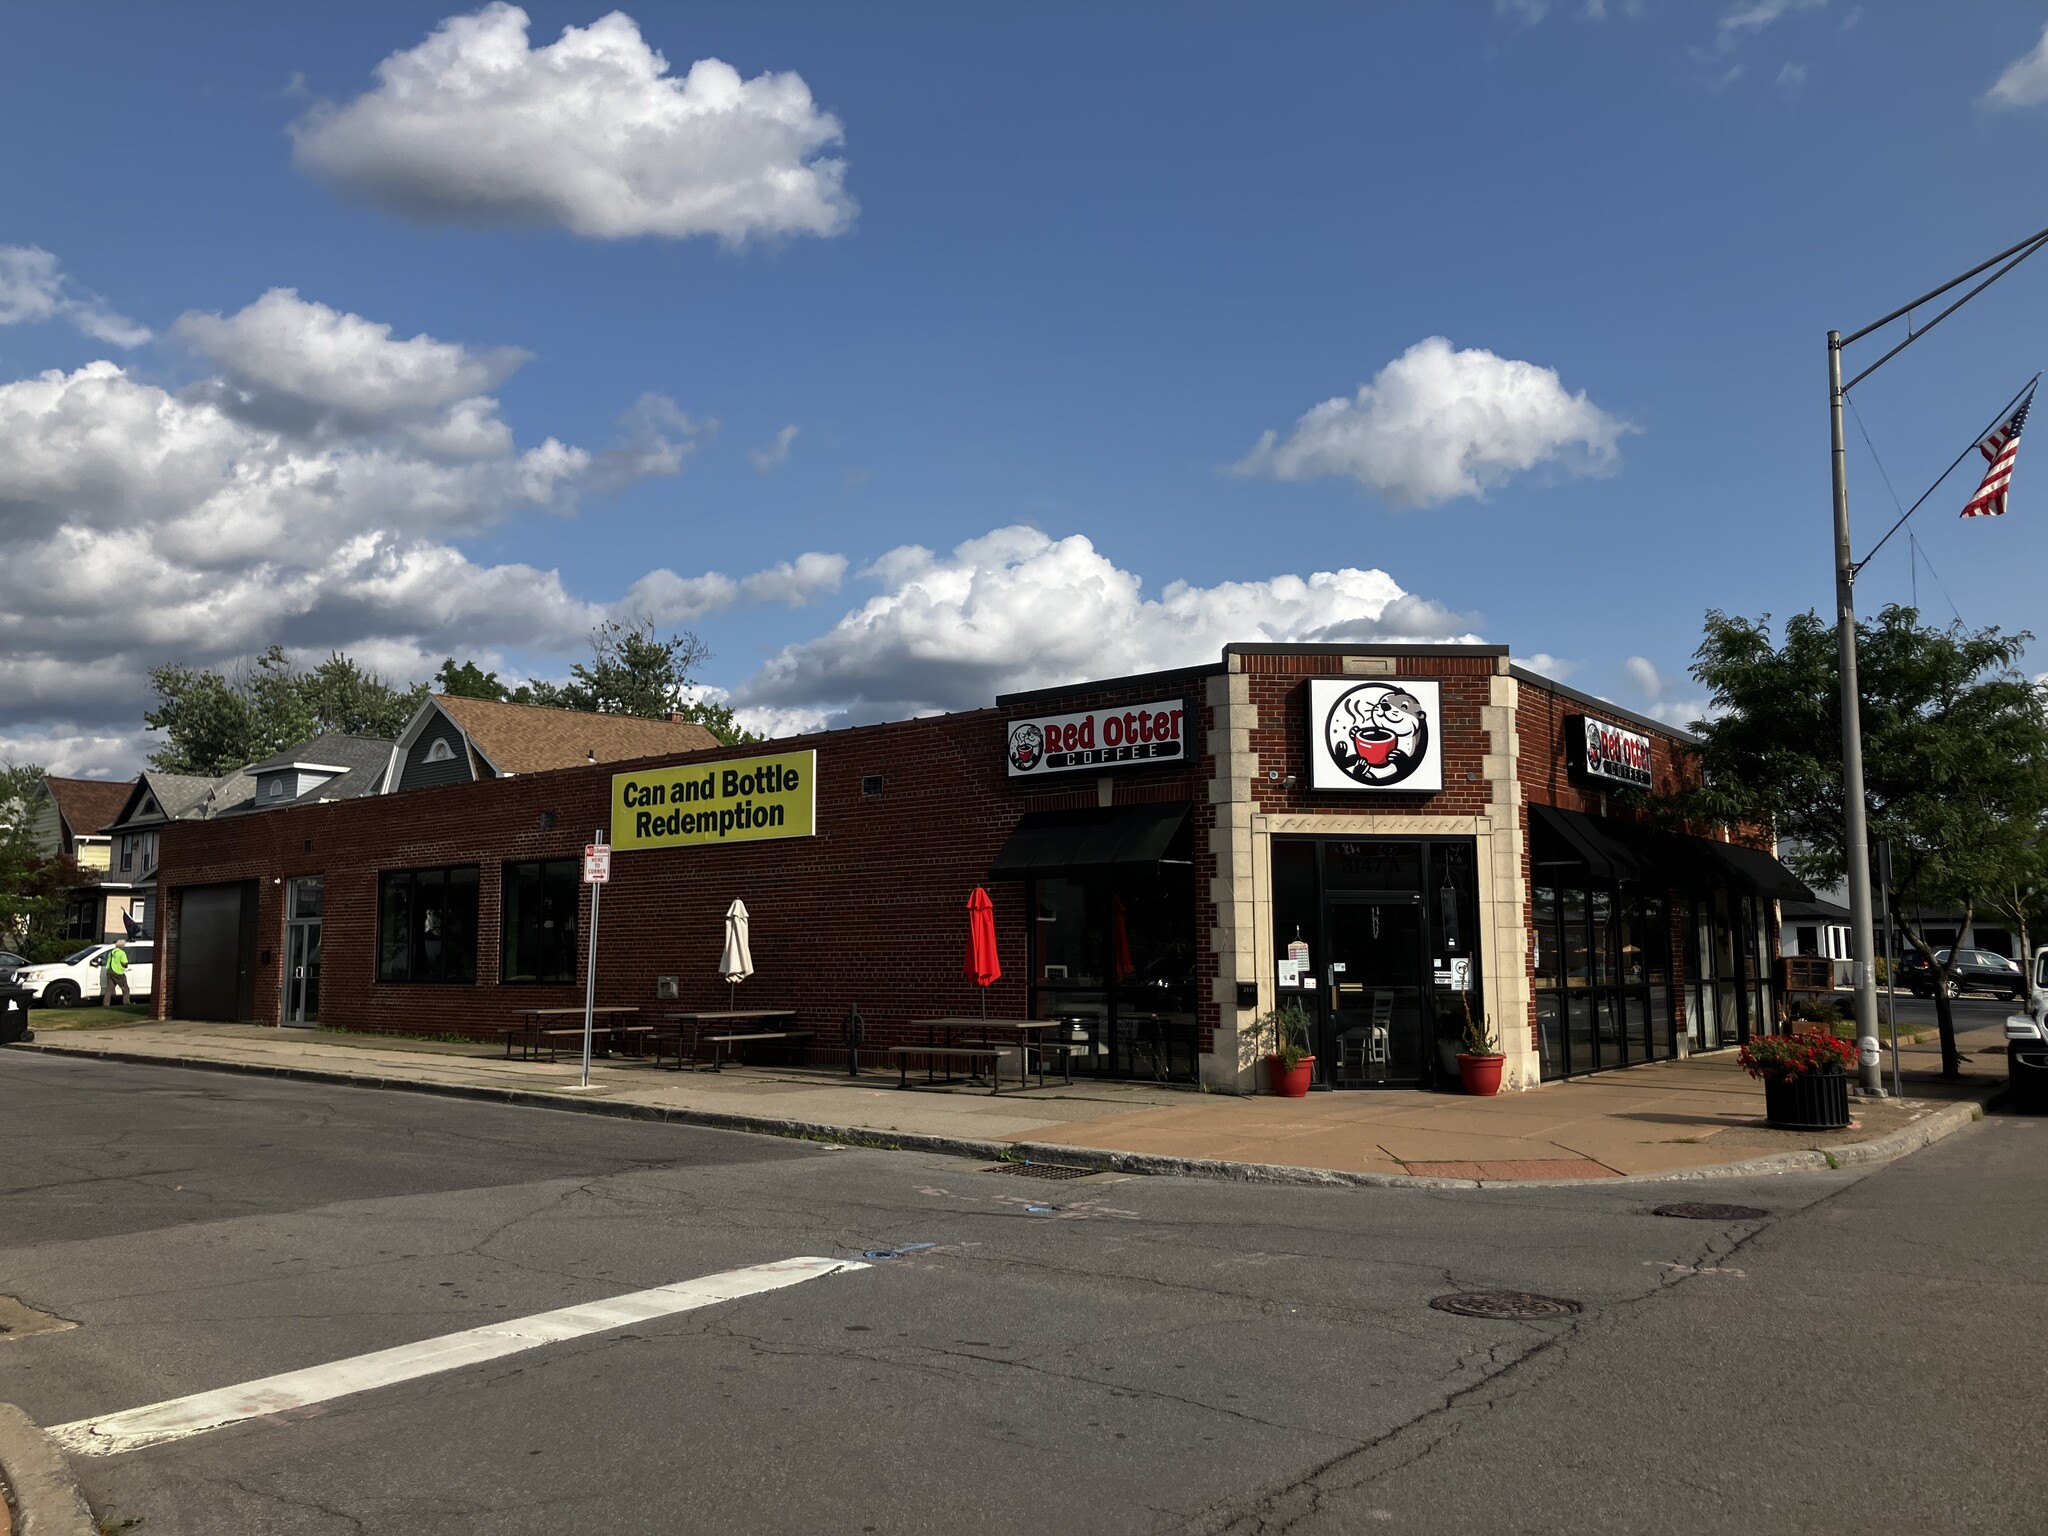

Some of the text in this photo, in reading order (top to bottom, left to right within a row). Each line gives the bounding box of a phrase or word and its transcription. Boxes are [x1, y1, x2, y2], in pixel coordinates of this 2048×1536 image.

[1044, 710, 1184, 754] Red Otter
[1601, 730, 1650, 771] Red Otter
[1067, 743, 1158, 766] COFFEE
[623, 764, 799, 808] Can and Bottle
[636, 800, 784, 838] Redemption
